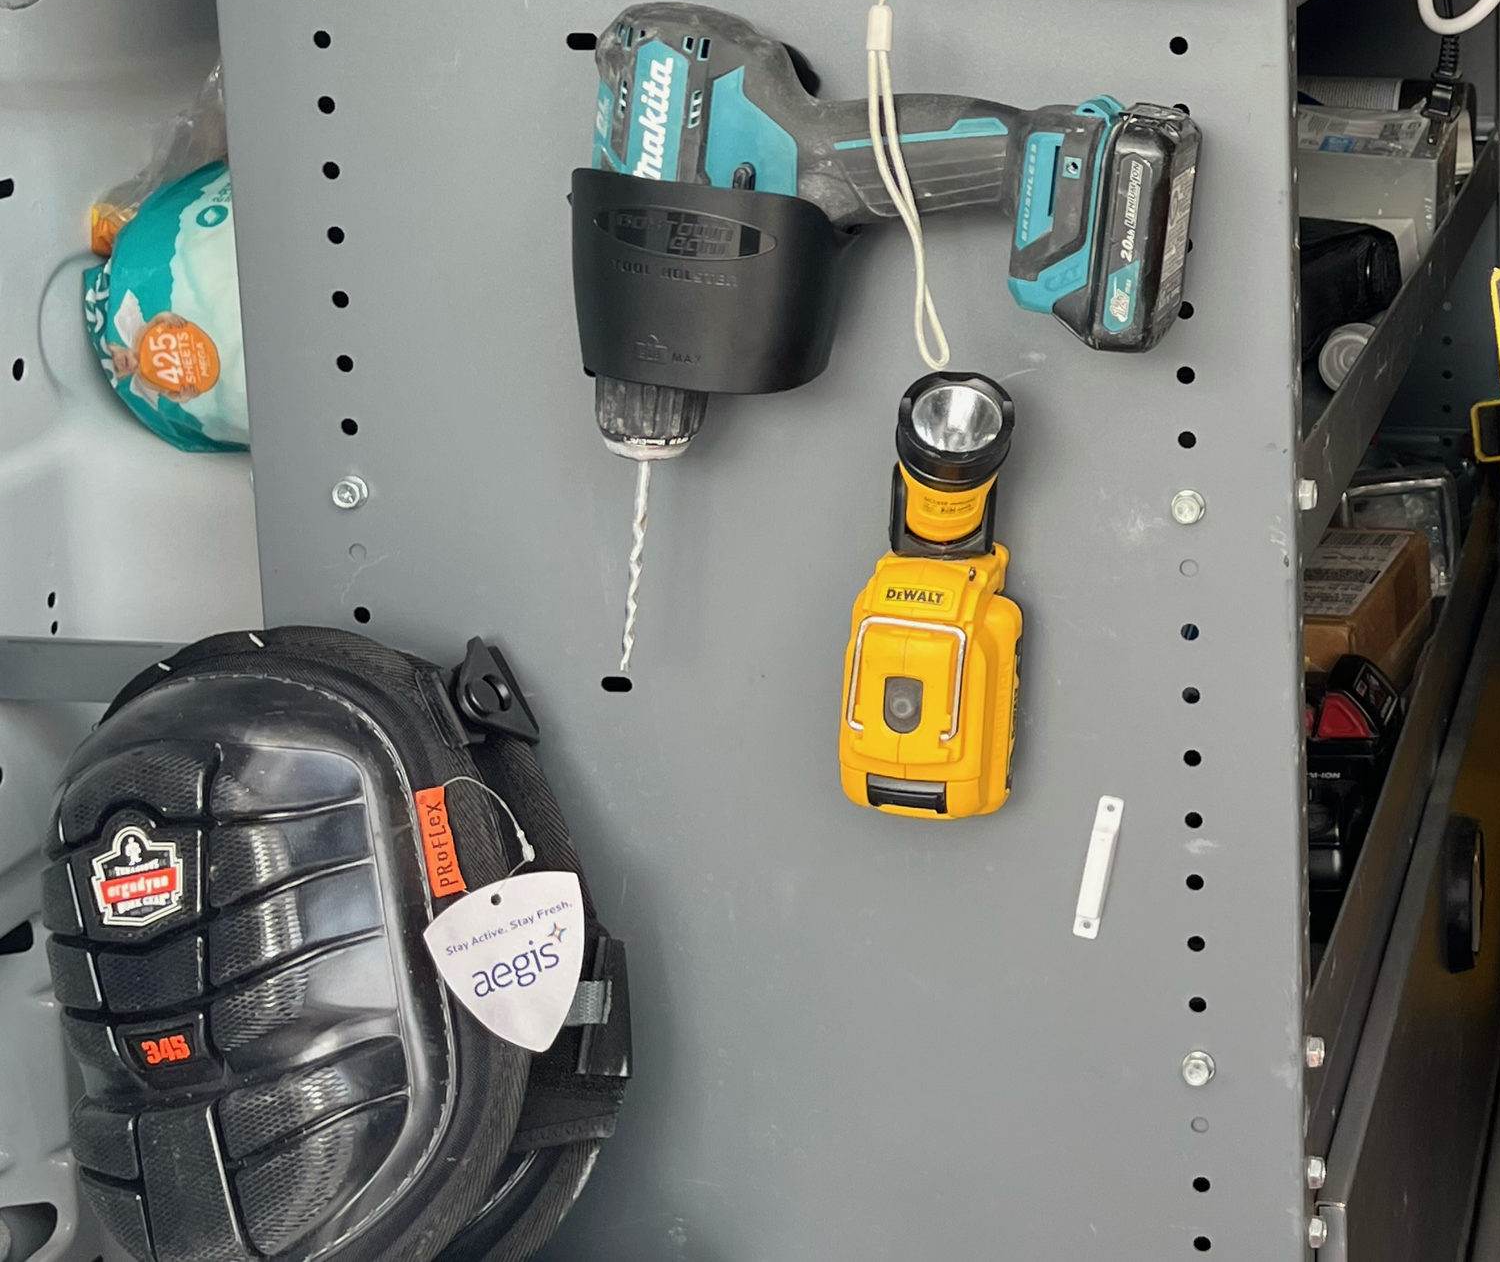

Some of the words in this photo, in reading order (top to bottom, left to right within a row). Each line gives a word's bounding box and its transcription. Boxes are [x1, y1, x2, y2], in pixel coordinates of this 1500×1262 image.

[1021, 143, 1038, 242] BRUSHLESS
[1124, 160, 1144, 229] LITHIUM-ION
[178, 331, 197, 384] SHEETS
[107, 875, 169, 899] ergodyne
[446, 940, 469, 957] Stay
[472, 927, 508, 947] Active.
[510, 913, 535, 931] Stay
[537, 900, 573, 920] Fresh.
[472, 940, 560, 998] aegis
[141, 1034, 191, 1065] 345
